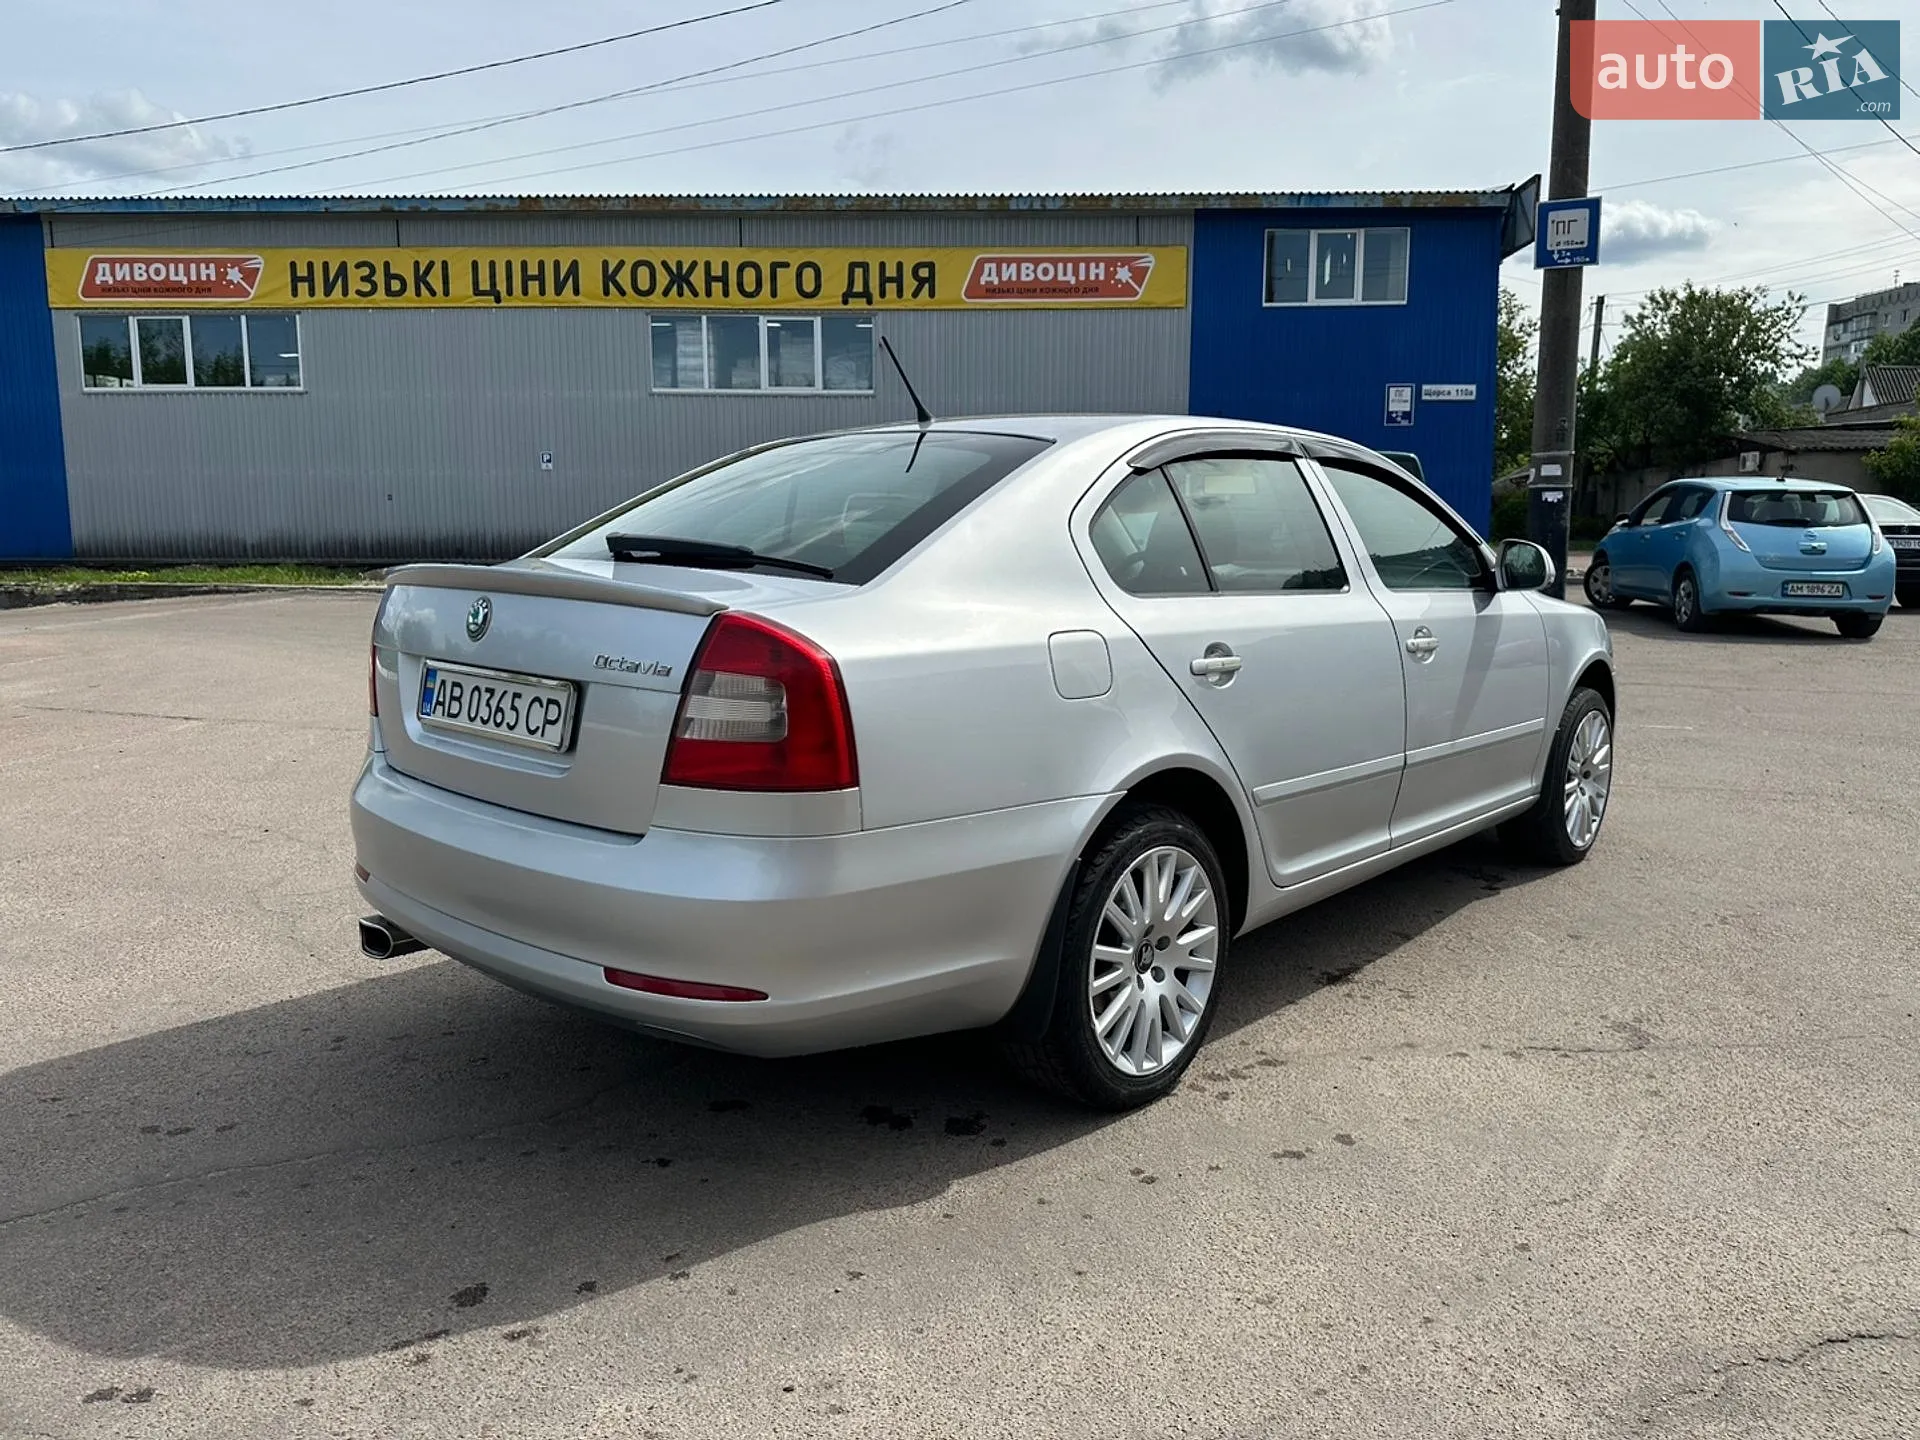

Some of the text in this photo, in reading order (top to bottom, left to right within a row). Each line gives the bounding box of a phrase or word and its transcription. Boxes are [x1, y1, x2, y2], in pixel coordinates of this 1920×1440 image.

[95, 262, 216, 285] ДИВОЦІН
[289, 258, 936, 306] НИЗЬКІ ЦІНИ КОЖНОГО ДНЯ
[980, 262, 1106, 285] ДИВОЦІН
[1789, 582, 1805, 594] AM
[1827, 583, 1841, 594] ZA
[592, 654, 673, 678] Octavia
[432, 678, 562, 738] AB 0365 CP
